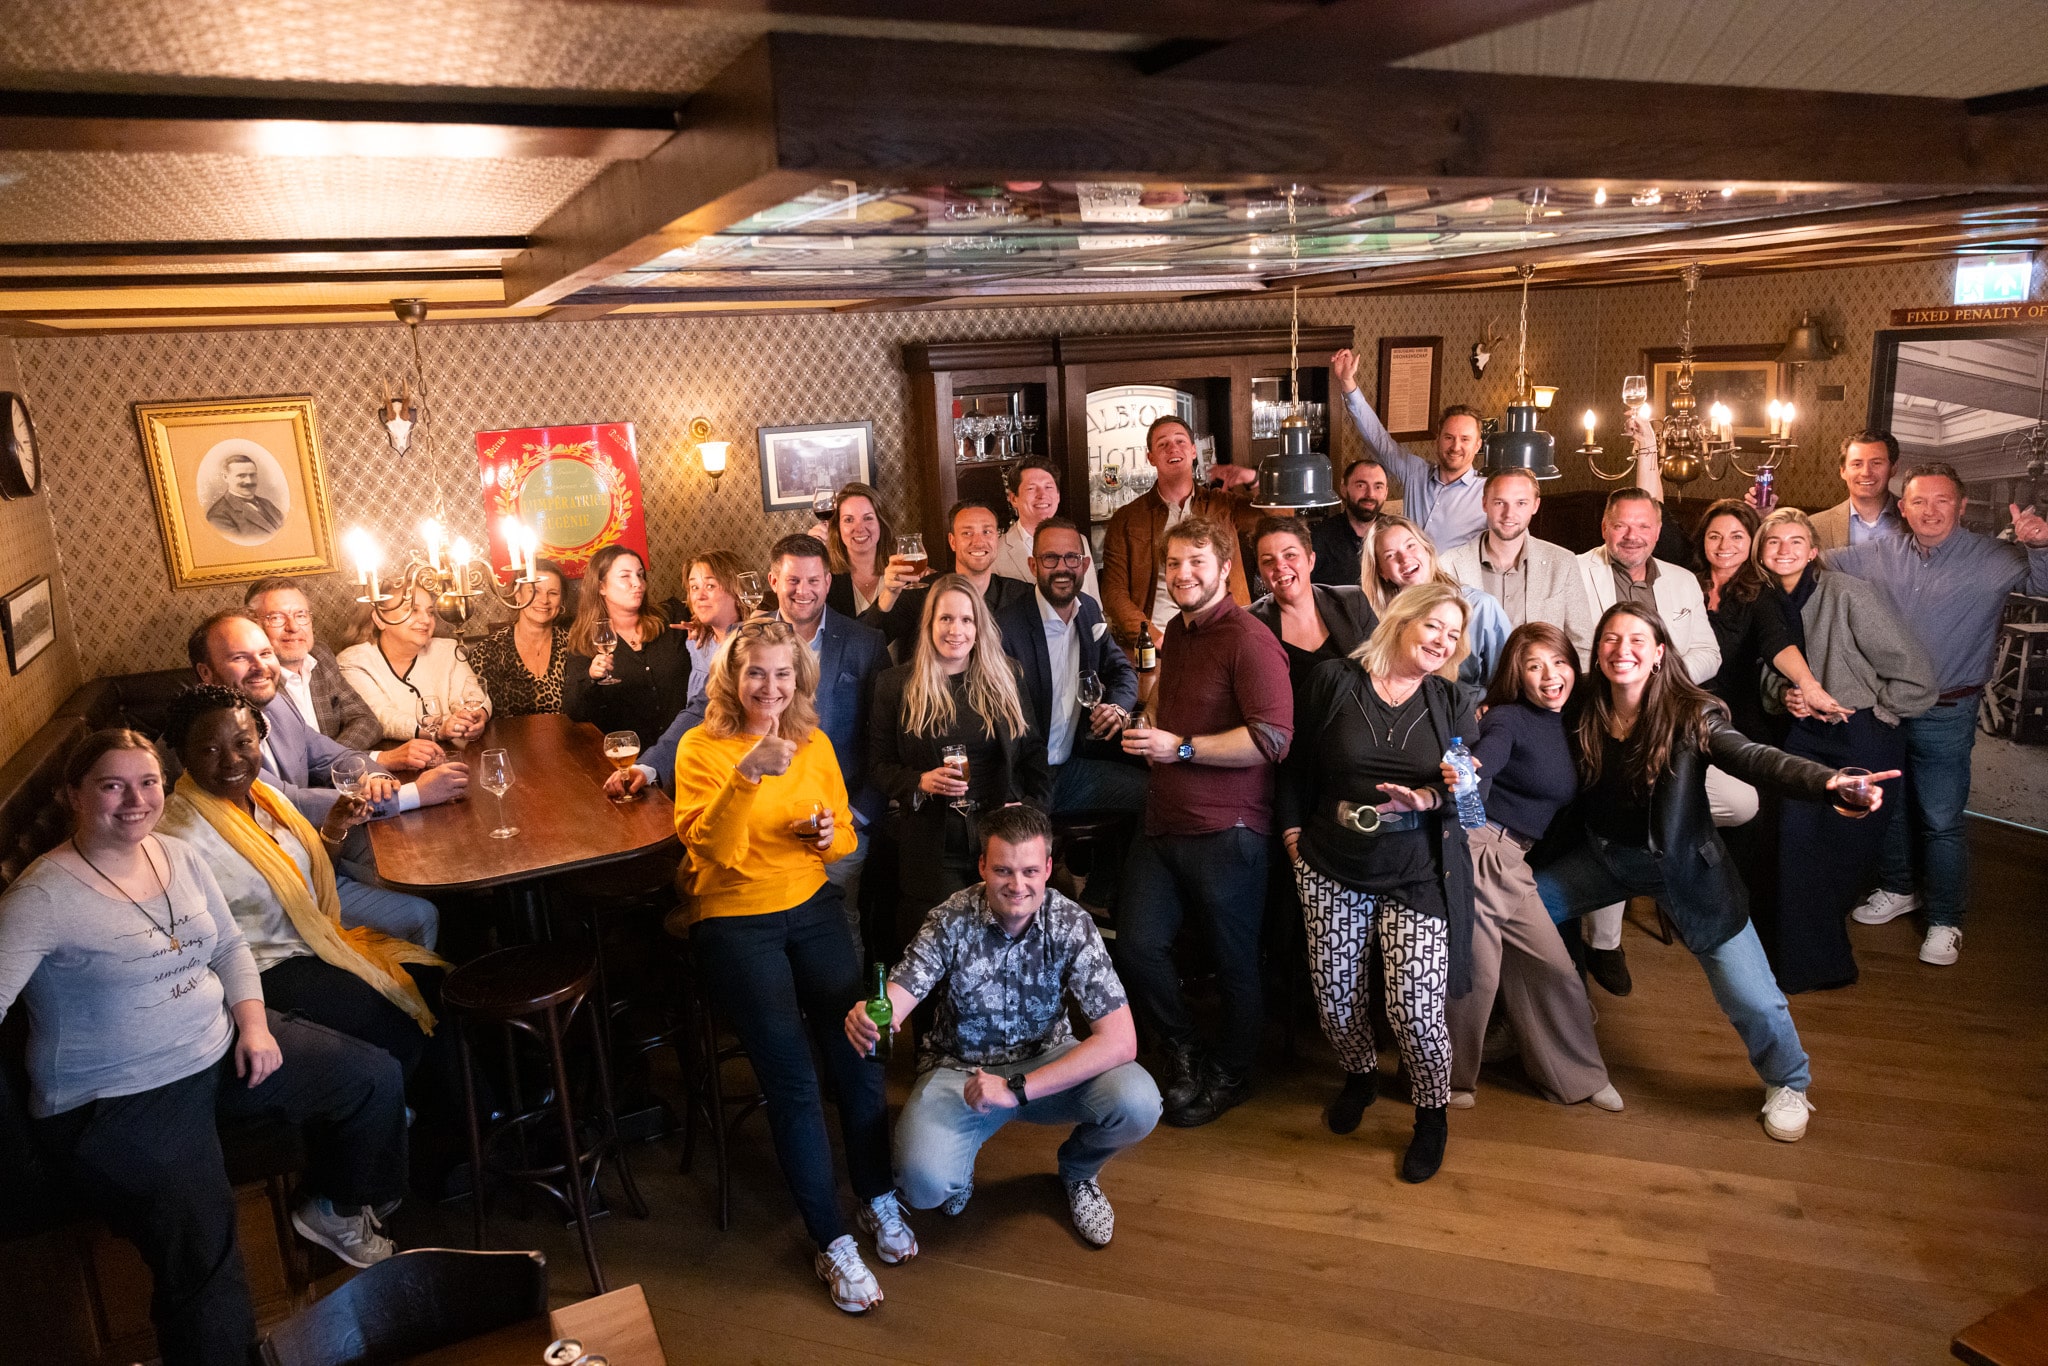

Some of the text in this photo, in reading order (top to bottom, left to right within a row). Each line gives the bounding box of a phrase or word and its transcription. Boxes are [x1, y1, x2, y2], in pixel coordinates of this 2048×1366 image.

[1907, 311, 1949, 322] FIXED
[1955, 307, 2021, 321] PENALTY
[1087, 404, 1176, 433] ALBIO
[1088, 446, 1149, 473] HOT
[523, 493, 609, 513] L'IMPÉRATRICE
